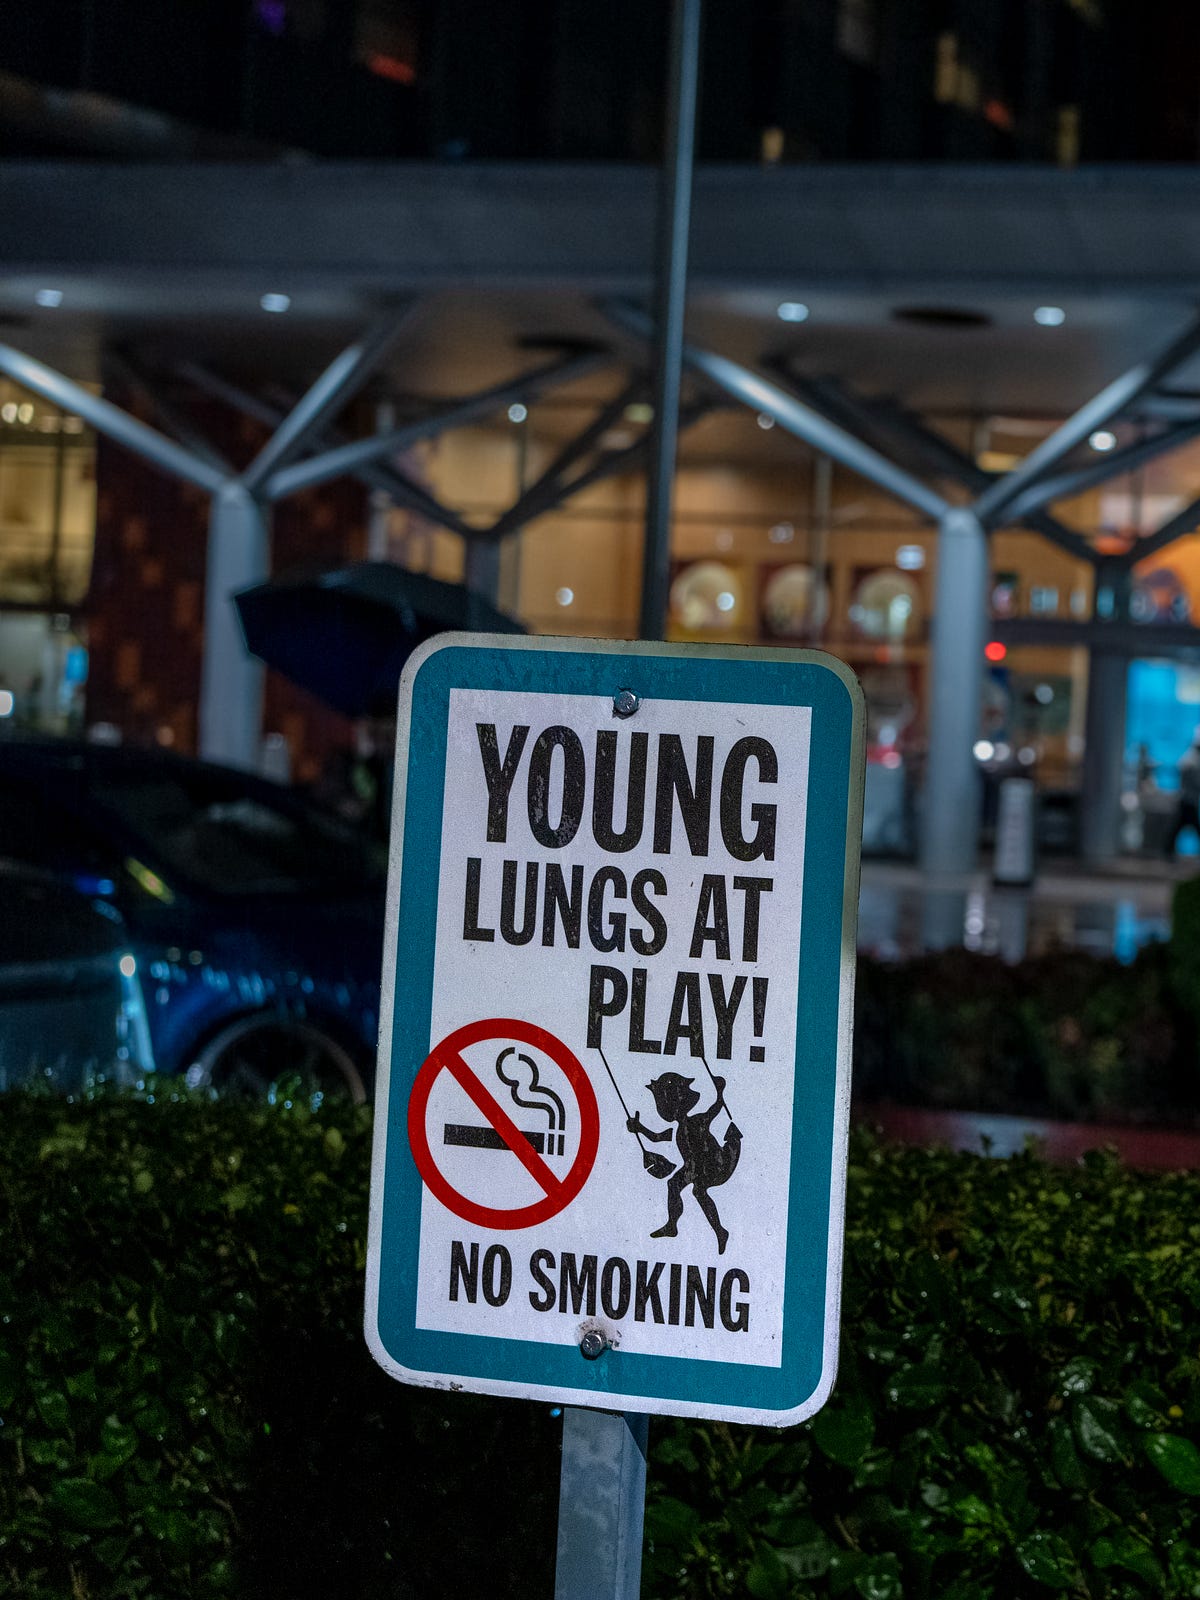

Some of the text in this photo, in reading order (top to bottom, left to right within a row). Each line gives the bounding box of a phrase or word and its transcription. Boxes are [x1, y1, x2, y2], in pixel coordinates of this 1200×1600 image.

[476, 722, 779, 862] YOUNG
[463, 856, 774, 963] LUNGS AT
[586, 964, 769, 1063] PLAY!
[448, 1240, 750, 1333] NO SMOKING
